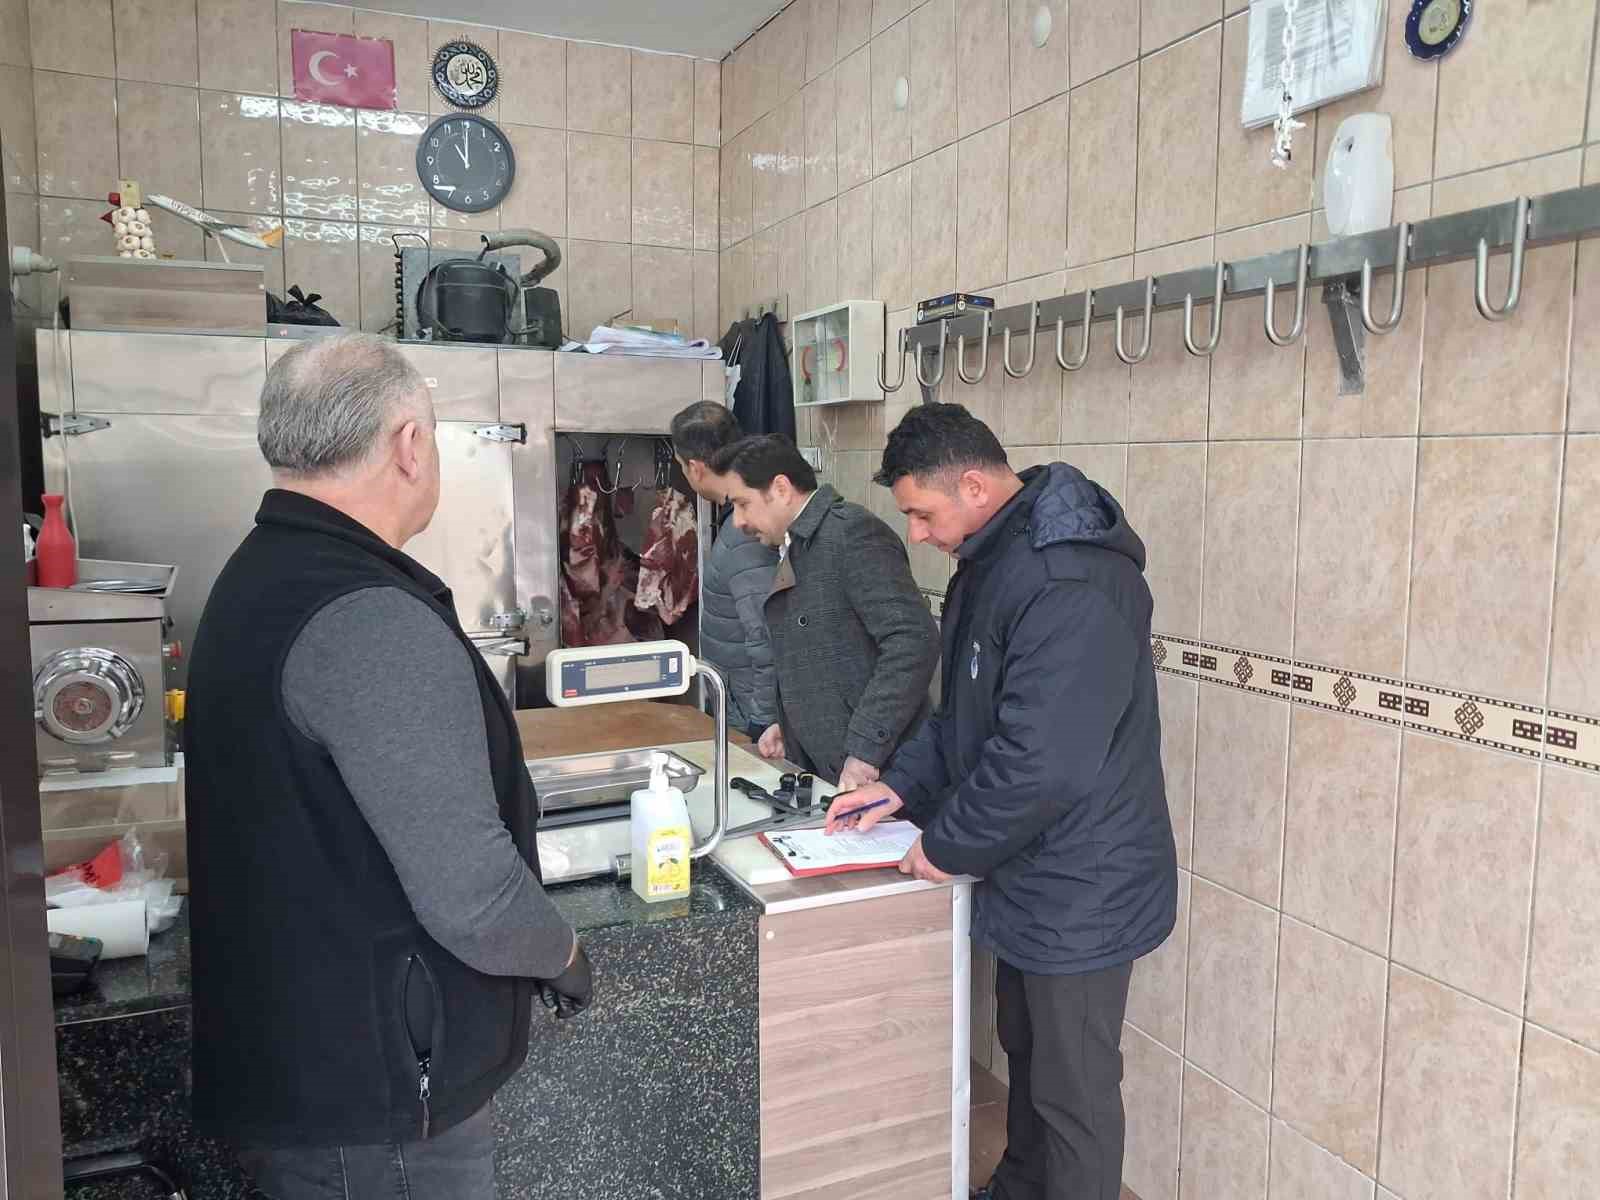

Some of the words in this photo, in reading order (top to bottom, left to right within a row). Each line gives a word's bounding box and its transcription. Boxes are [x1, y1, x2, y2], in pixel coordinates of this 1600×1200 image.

[430, 138, 439, 148] 10
[494, 142, 501, 152] 2
[427, 156, 434, 166] 9
[433, 175, 440, 184] 8
[465, 195, 472, 204] 6
[483, 190, 489, 200] 5
